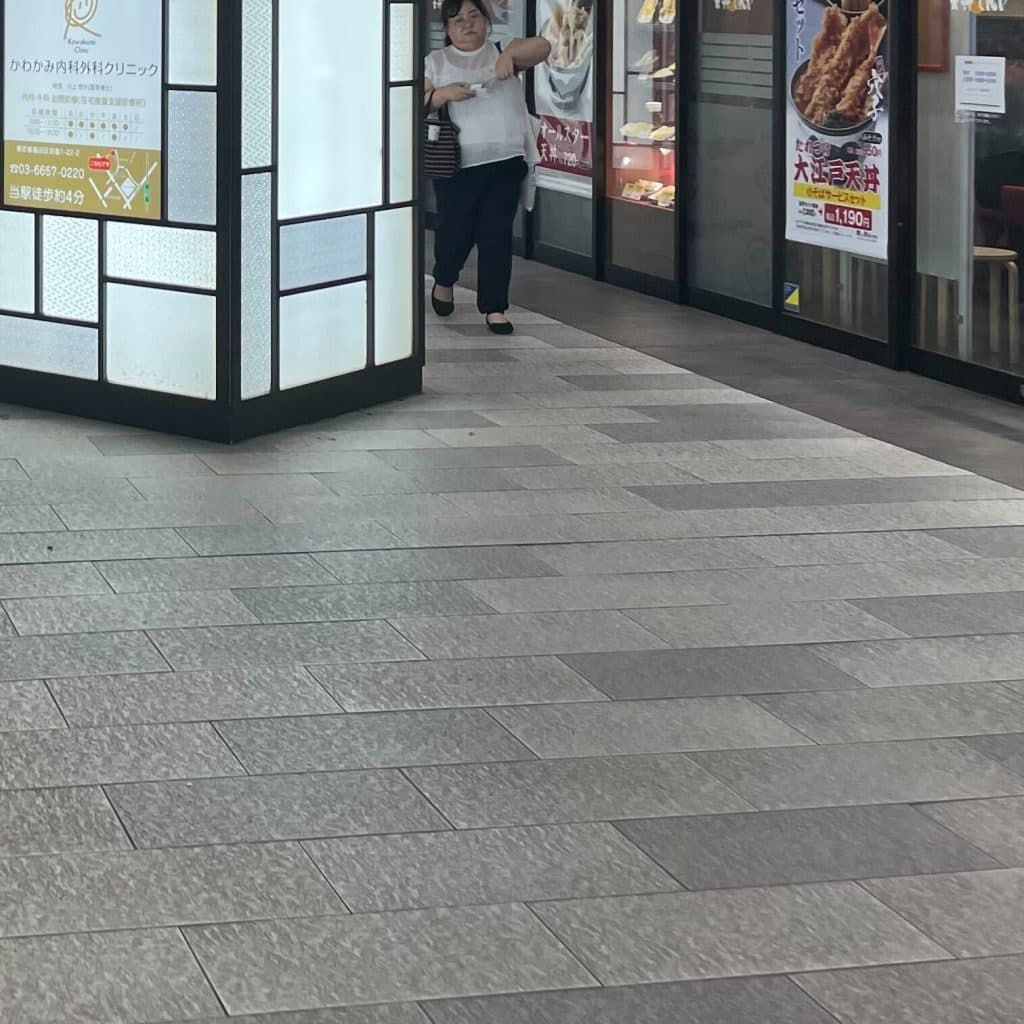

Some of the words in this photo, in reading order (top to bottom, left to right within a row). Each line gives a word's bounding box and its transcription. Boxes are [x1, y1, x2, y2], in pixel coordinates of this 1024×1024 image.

[10, 59, 159, 78] かわかみ内科外科クリニック
[541, 121, 590, 144] オールスター
[794, 154, 881, 193] 大江戸天丼
[9, 184, 85, 205] 当駅徒歩約4分
